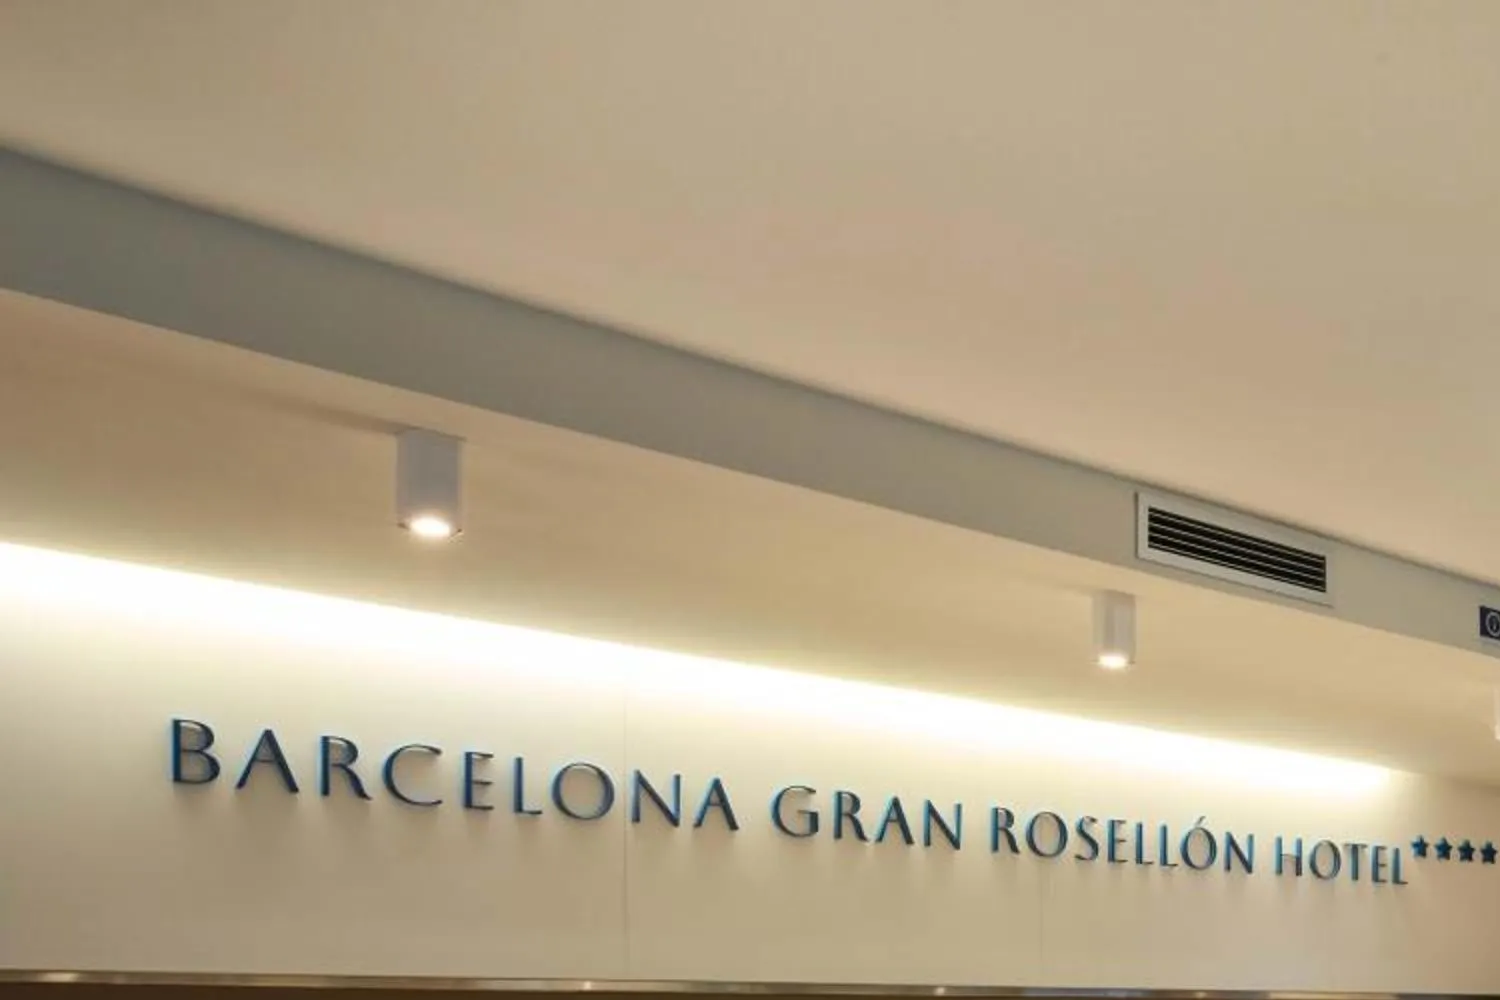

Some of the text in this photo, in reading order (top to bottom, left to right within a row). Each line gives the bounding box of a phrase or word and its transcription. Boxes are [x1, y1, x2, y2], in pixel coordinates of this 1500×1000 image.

[170, 717, 1409, 886] BARCELONA GRAN ROSELLÓN HOTEL
